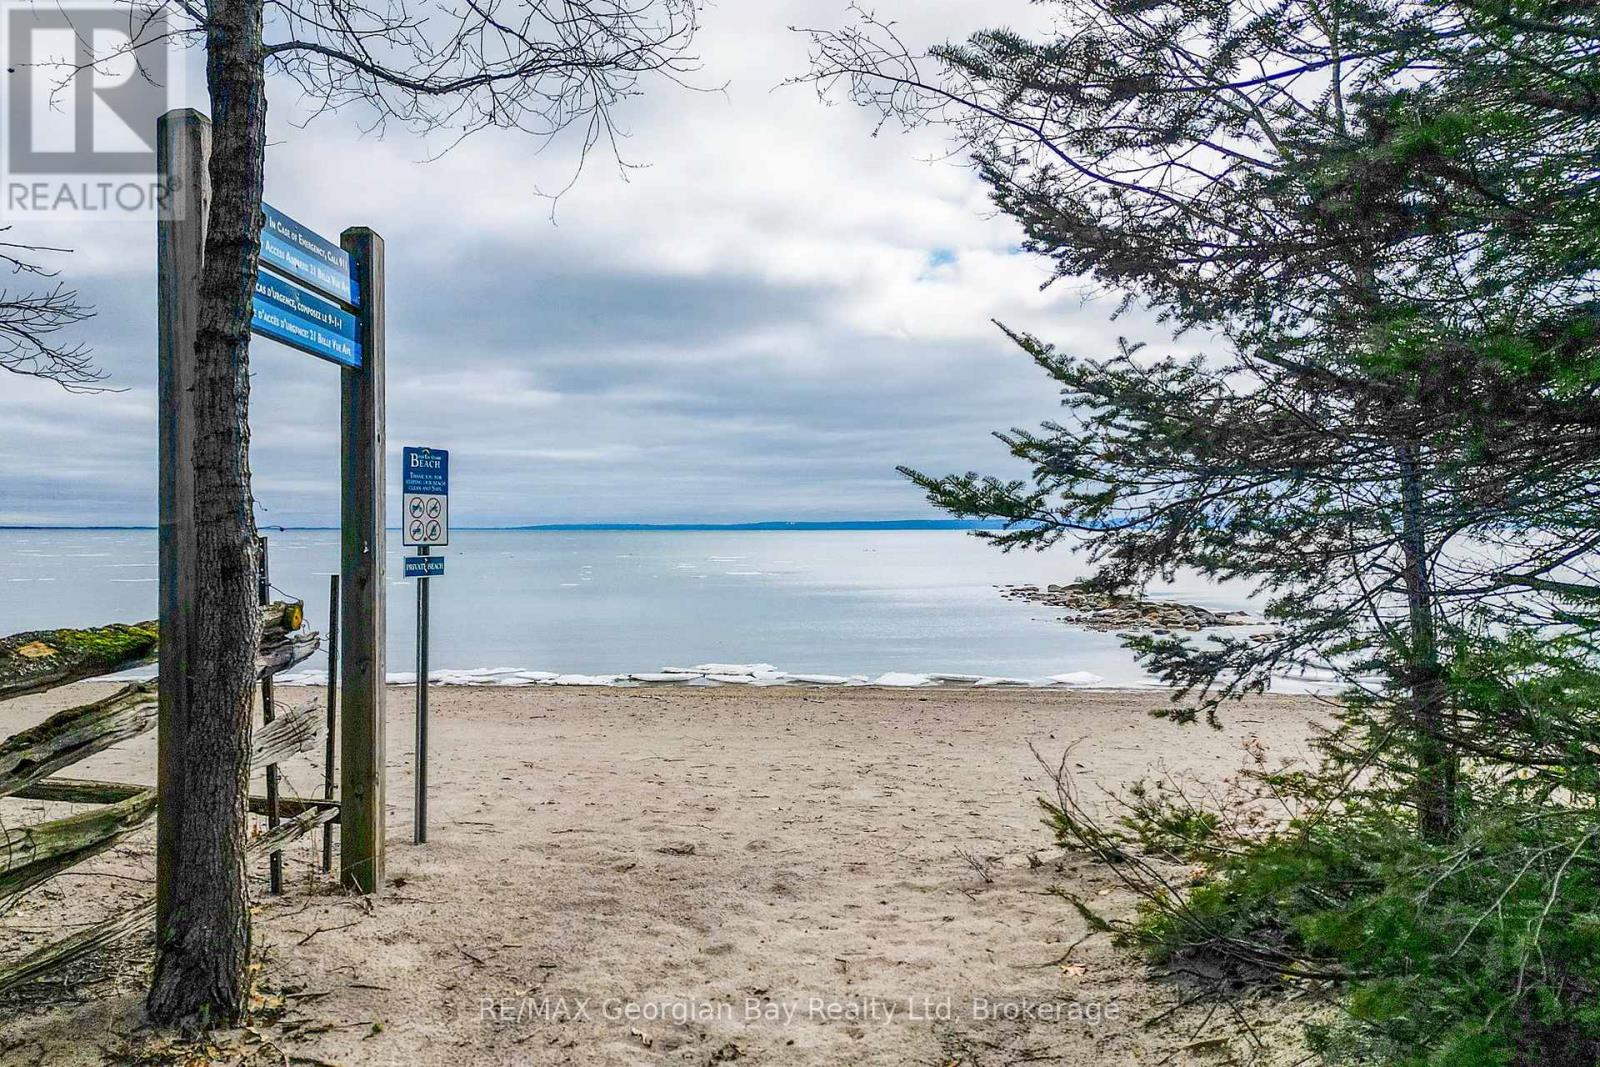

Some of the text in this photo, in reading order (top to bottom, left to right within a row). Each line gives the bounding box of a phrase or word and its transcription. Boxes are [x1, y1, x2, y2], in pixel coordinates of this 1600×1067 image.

[255, 283, 266, 294] CAS
[267, 286, 297, 311] D'URGENCE,
[297, 303, 321, 320] COMPOSEZ
[328, 314, 342, 329] 9-1-1
[310, 329, 316, 342] 21
[317, 334, 331, 348] BELLE
[410, 453, 441, 468] BEACH
